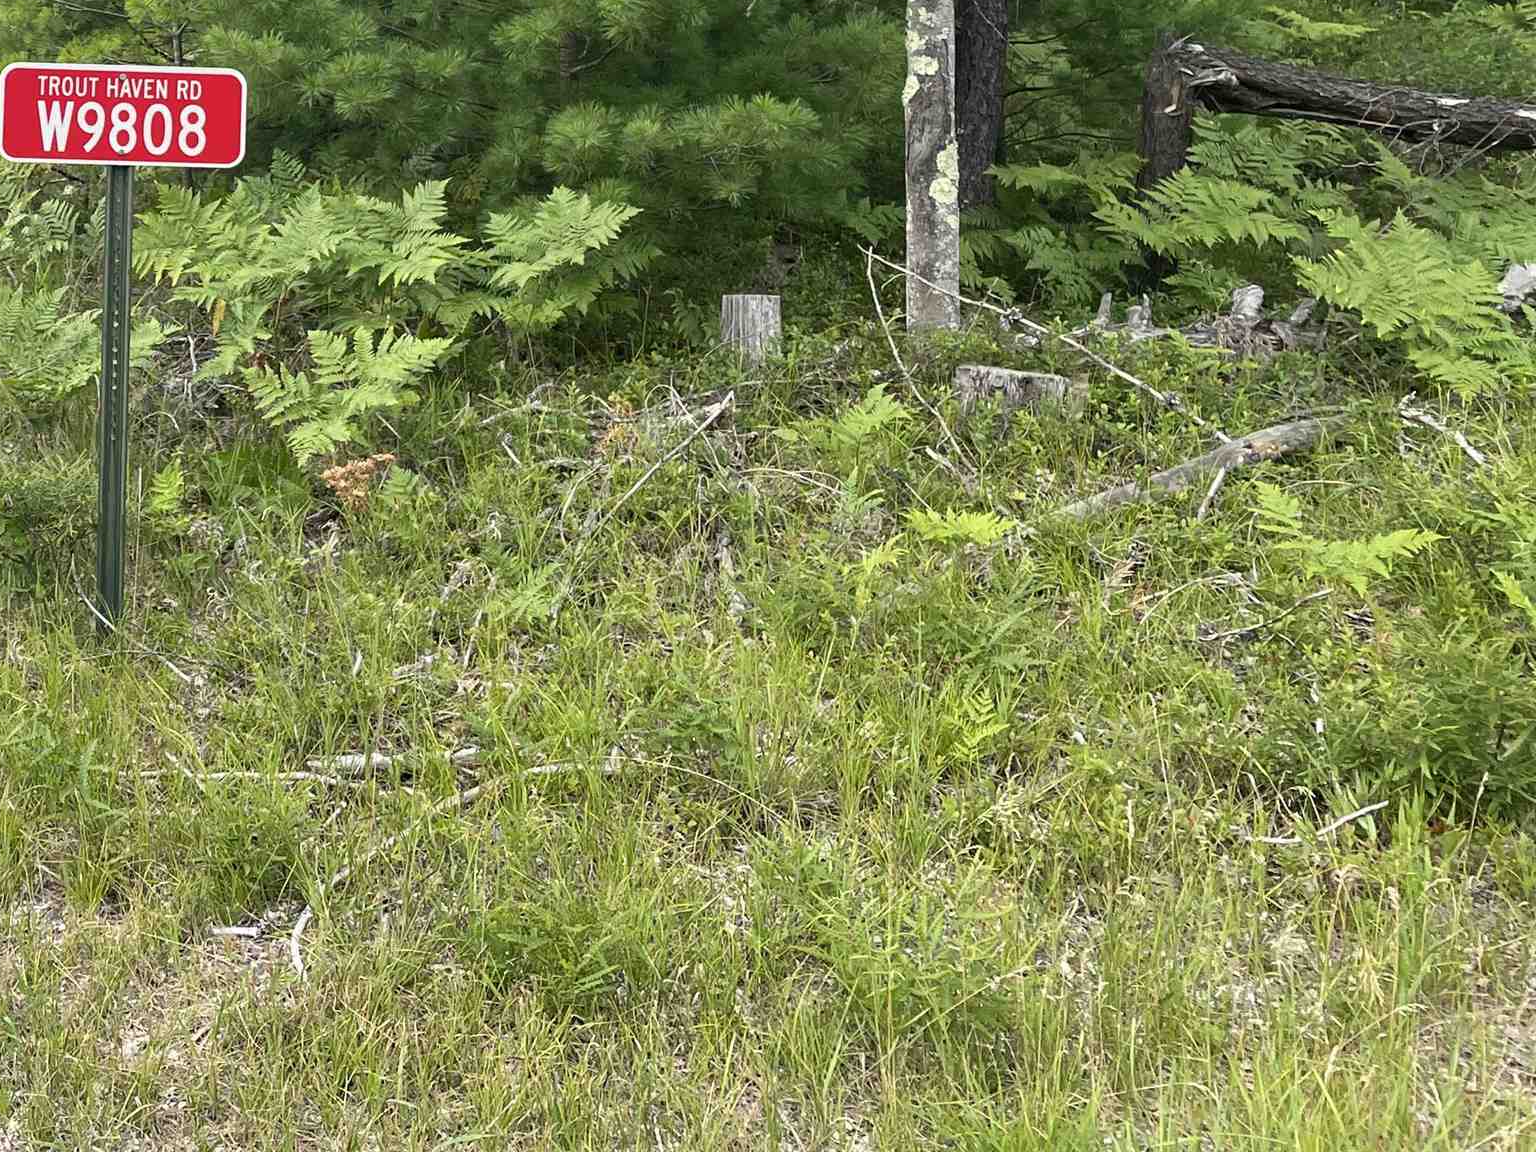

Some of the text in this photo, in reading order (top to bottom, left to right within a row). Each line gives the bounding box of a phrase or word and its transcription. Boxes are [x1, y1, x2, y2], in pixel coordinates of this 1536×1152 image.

[37, 75, 202, 101] TROUT HAVEN RD
[37, 100, 207, 157] W9808
